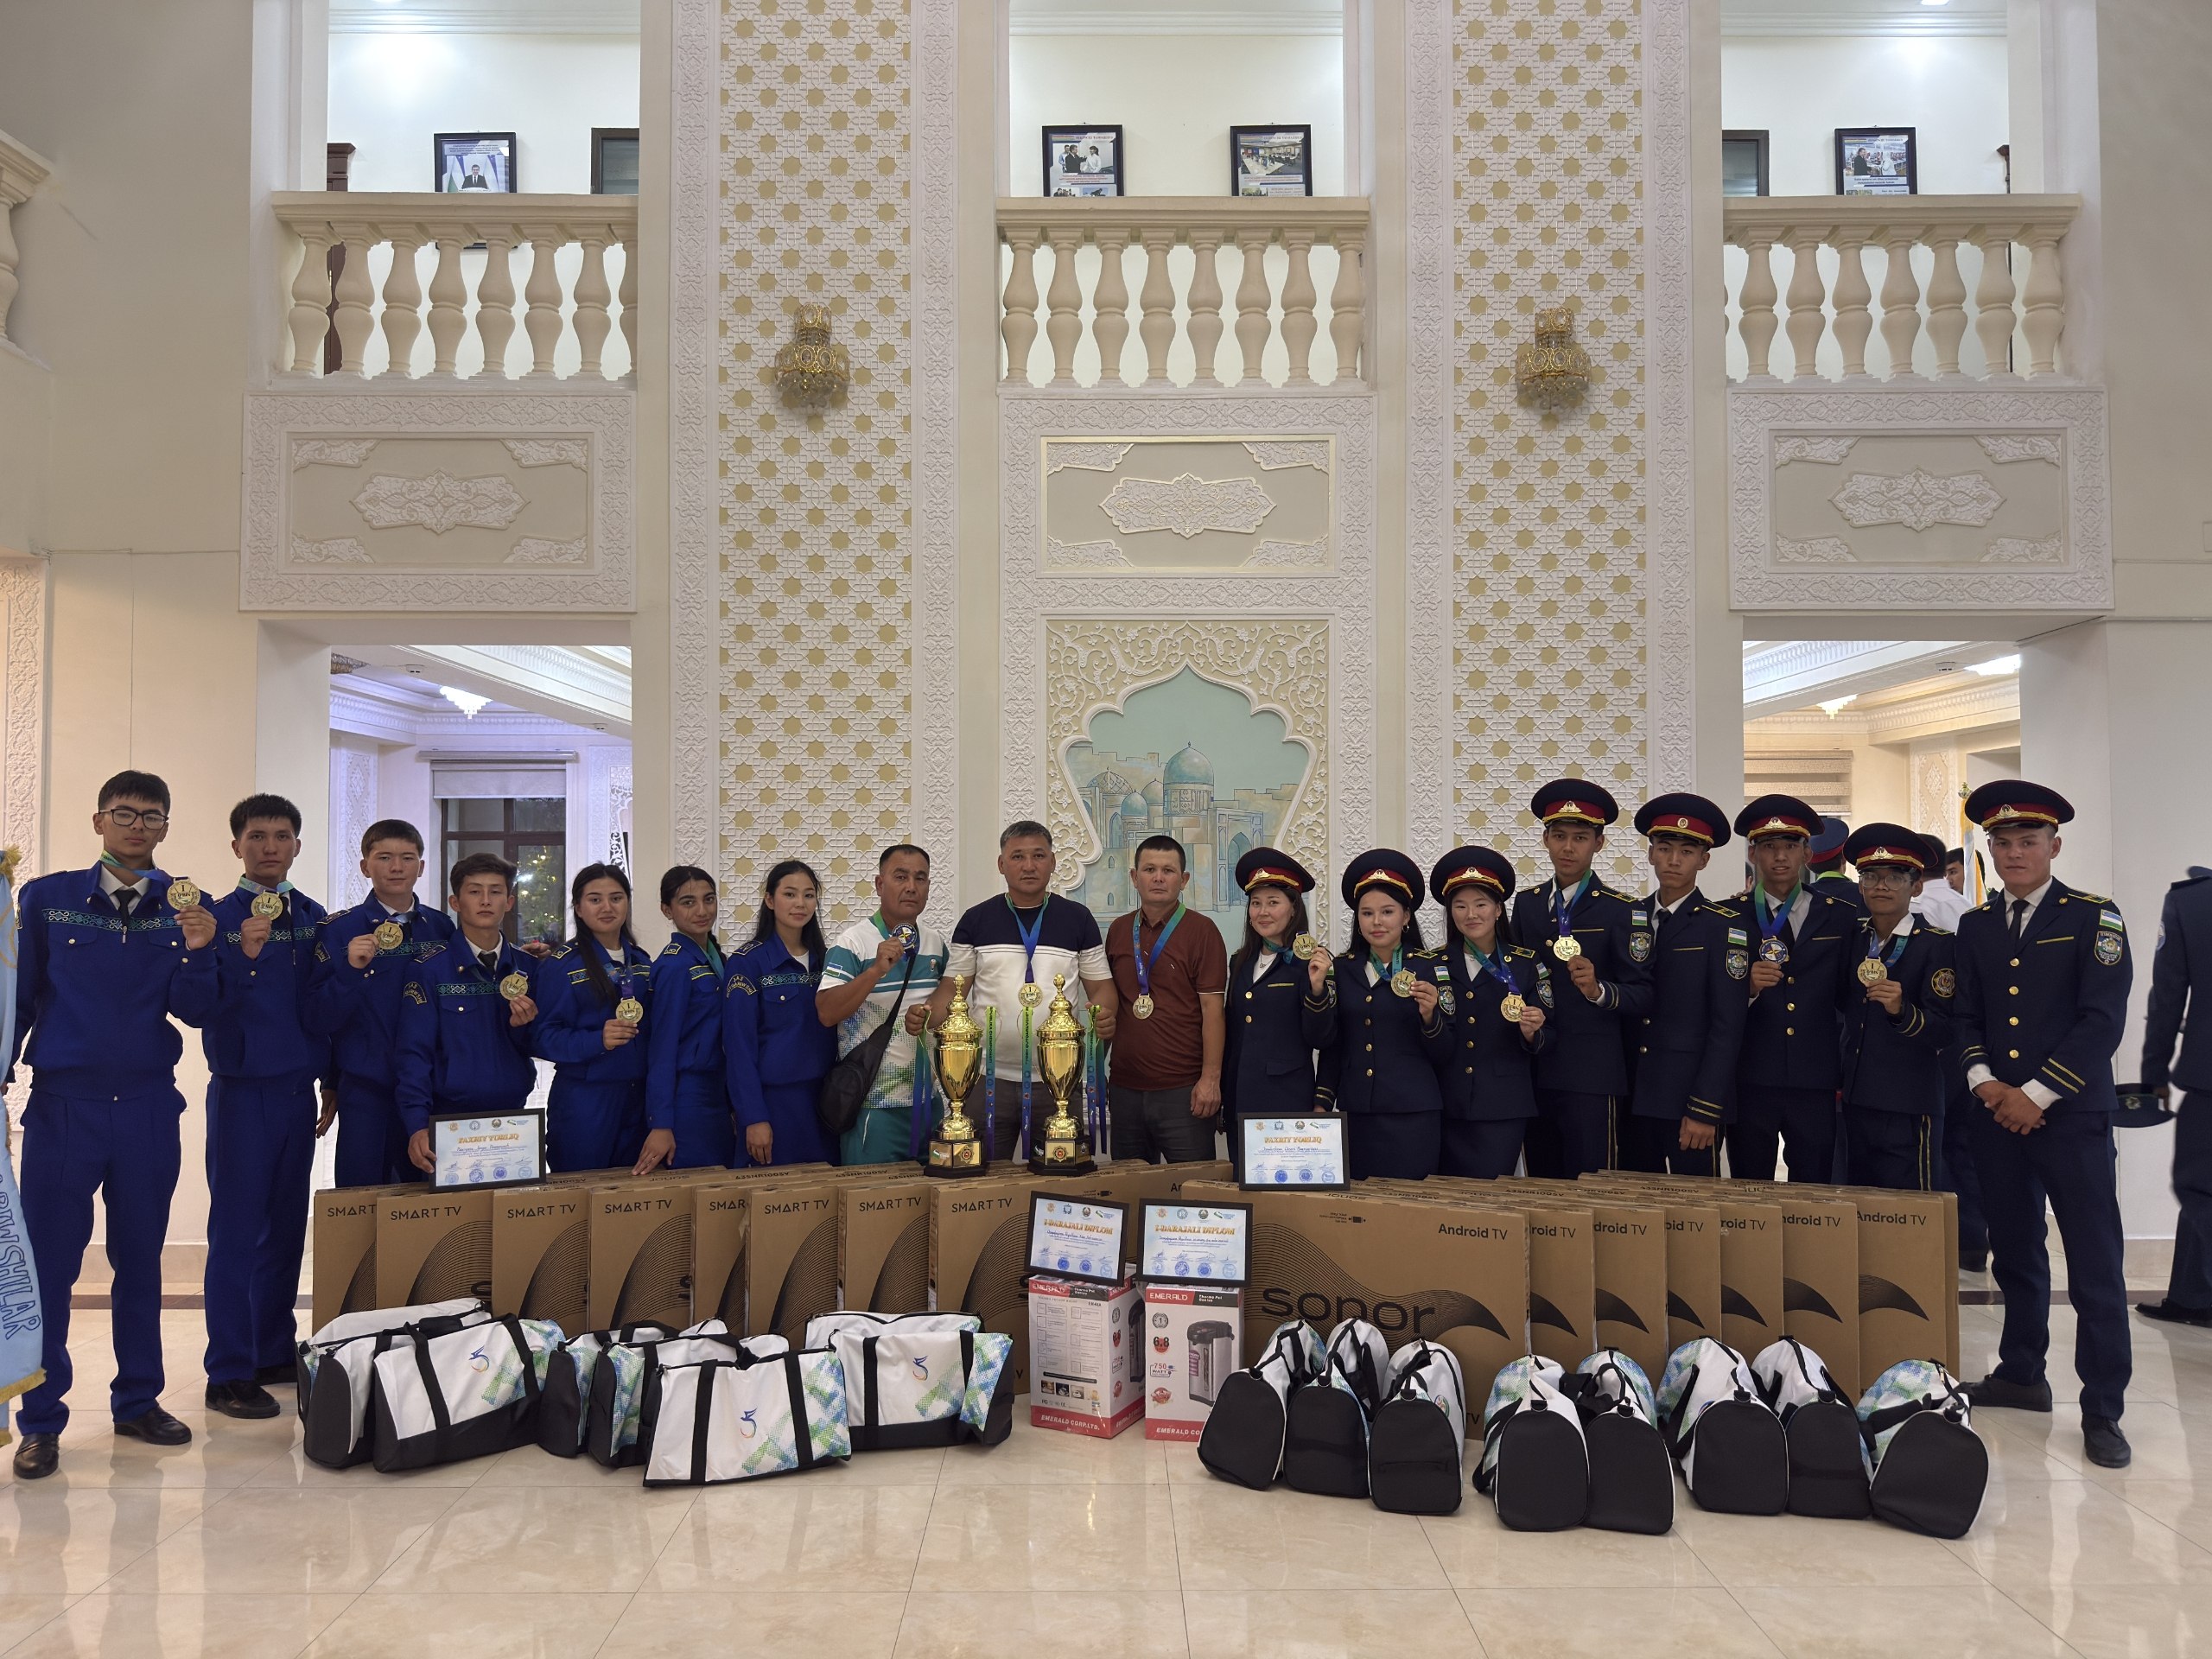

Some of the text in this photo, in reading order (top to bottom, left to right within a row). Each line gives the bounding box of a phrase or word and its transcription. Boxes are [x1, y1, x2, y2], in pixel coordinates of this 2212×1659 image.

[327, 1204, 377, 1217] SMART
[604, 1199, 673, 1214] SMART TV
[709, 1198, 748, 1211] SMAR
[765, 1199, 830, 1215] SMART TV
[859, 1197, 922, 1211] SMART TV
[951, 1198, 1013, 1213] SMART TV
[391, 1205, 462, 1221] SMART TV
[507, 1204, 576, 1219] SMART TV
[1856, 1211, 1927, 1226] Android TV
[1593, 1221, 1647, 1236] droid TV
[1688, 1221, 1704, 1232] TV
[1750, 1220, 1766, 1230] TV
[1825, 1217, 1841, 1228] TV
[1438, 1223, 1508, 1241] Android TV
[1560, 1226, 1576, 1238] TV
[1149, 1292, 1189, 1301] EMERALD
[1262, 1287, 1435, 1334] sonor
[1154, 1336, 1170, 1348] 6.8
[1041, 1414, 1070, 1425] EMERALD
